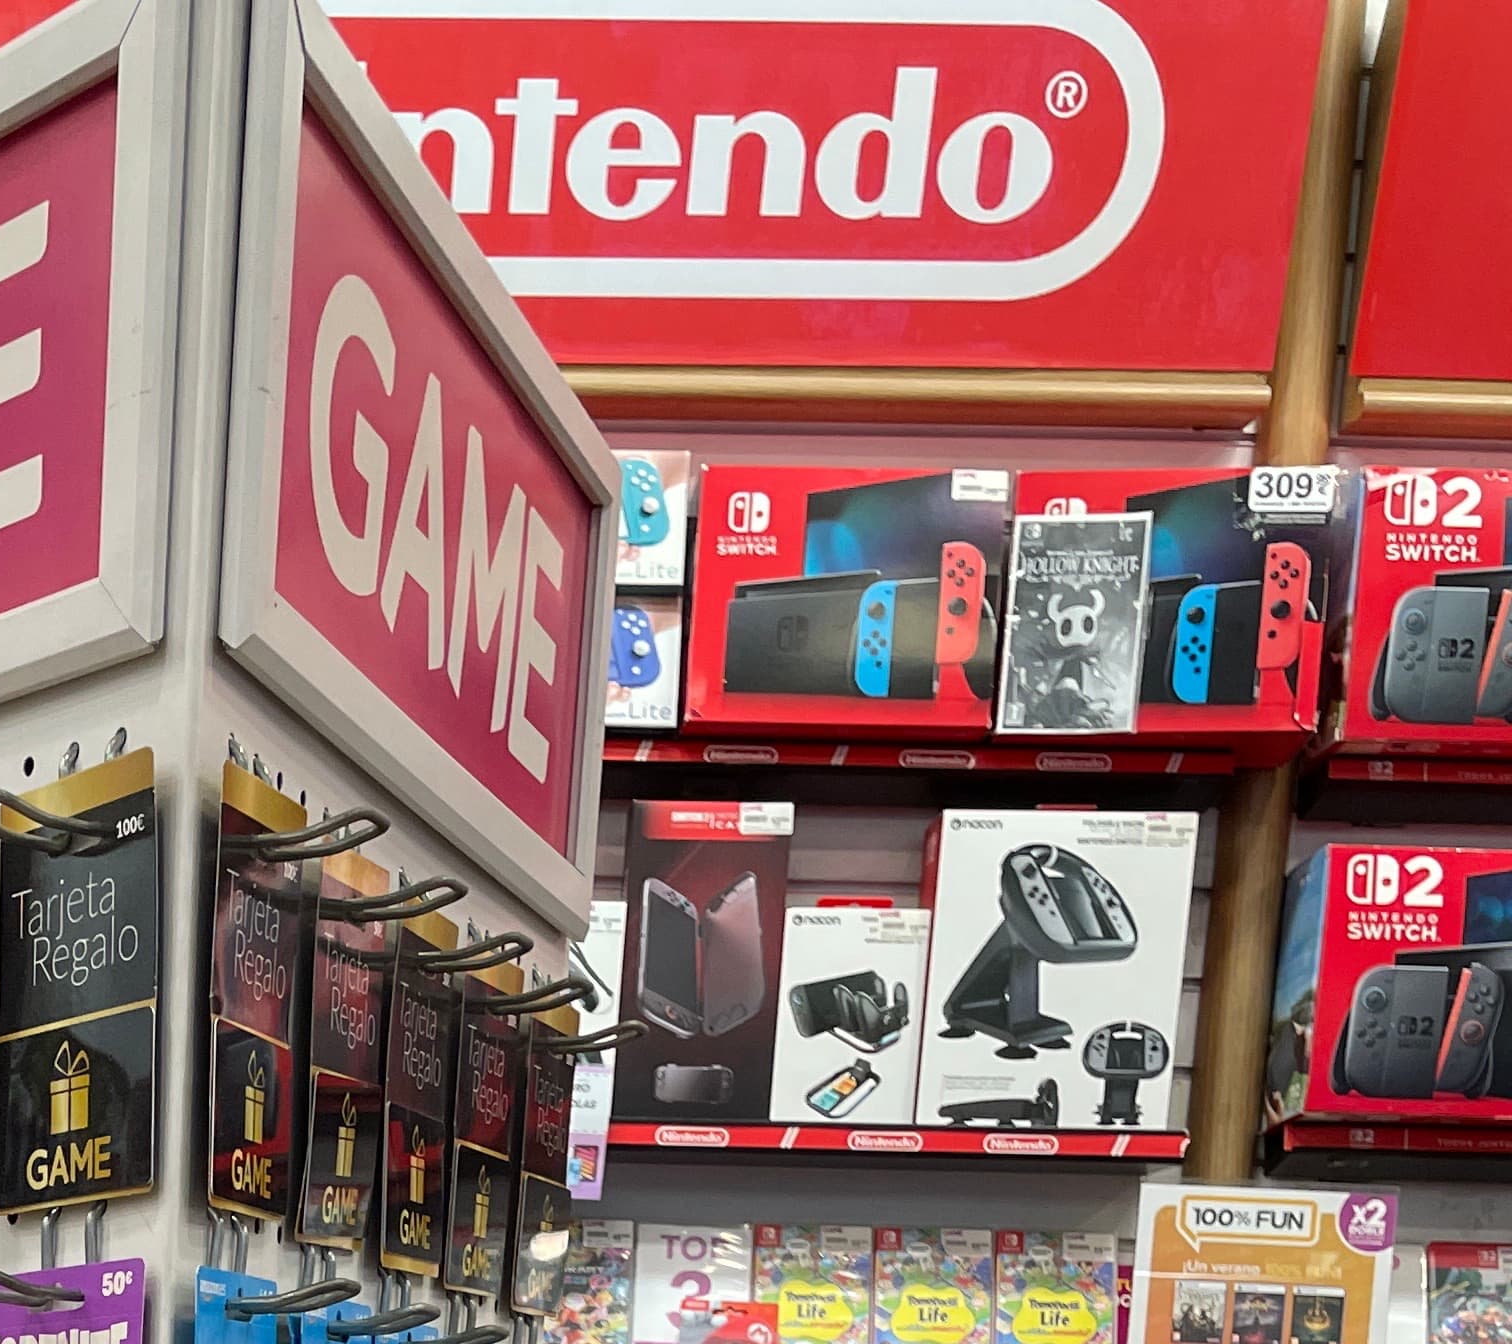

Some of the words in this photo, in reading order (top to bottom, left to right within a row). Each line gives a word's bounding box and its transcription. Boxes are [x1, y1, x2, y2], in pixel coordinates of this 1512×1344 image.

[1255, 473, 1312, 498] 309
[309, 274, 565, 784] GAME
[1386, 533, 1478, 544] NINTENDO
[716, 544, 777, 556] SWITCH
[1385, 544, 1480, 562] SWITCH
[635, 563, 678, 579] Lite
[627, 705, 672, 721] Lite
[115, 814, 145, 838] 100€
[11, 870, 116, 940] Tarjeta
[226, 868, 280, 944] Tarjeta
[1348, 912, 1438, 923] NINTENDO
[1347, 923, 1441, 941] SWITCH
[32, 914, 138, 988] Regalo
[234, 928, 286, 1001] Regalo
[26, 1135, 112, 1191] GAME
[231, 1148, 272, 1201] GAME
[399, 1208, 431, 1251] GAME
[1256, 1209, 1305, 1230] FUN
[798, 1305, 827, 1319] Life
[919, 1308, 948, 1323] Life
